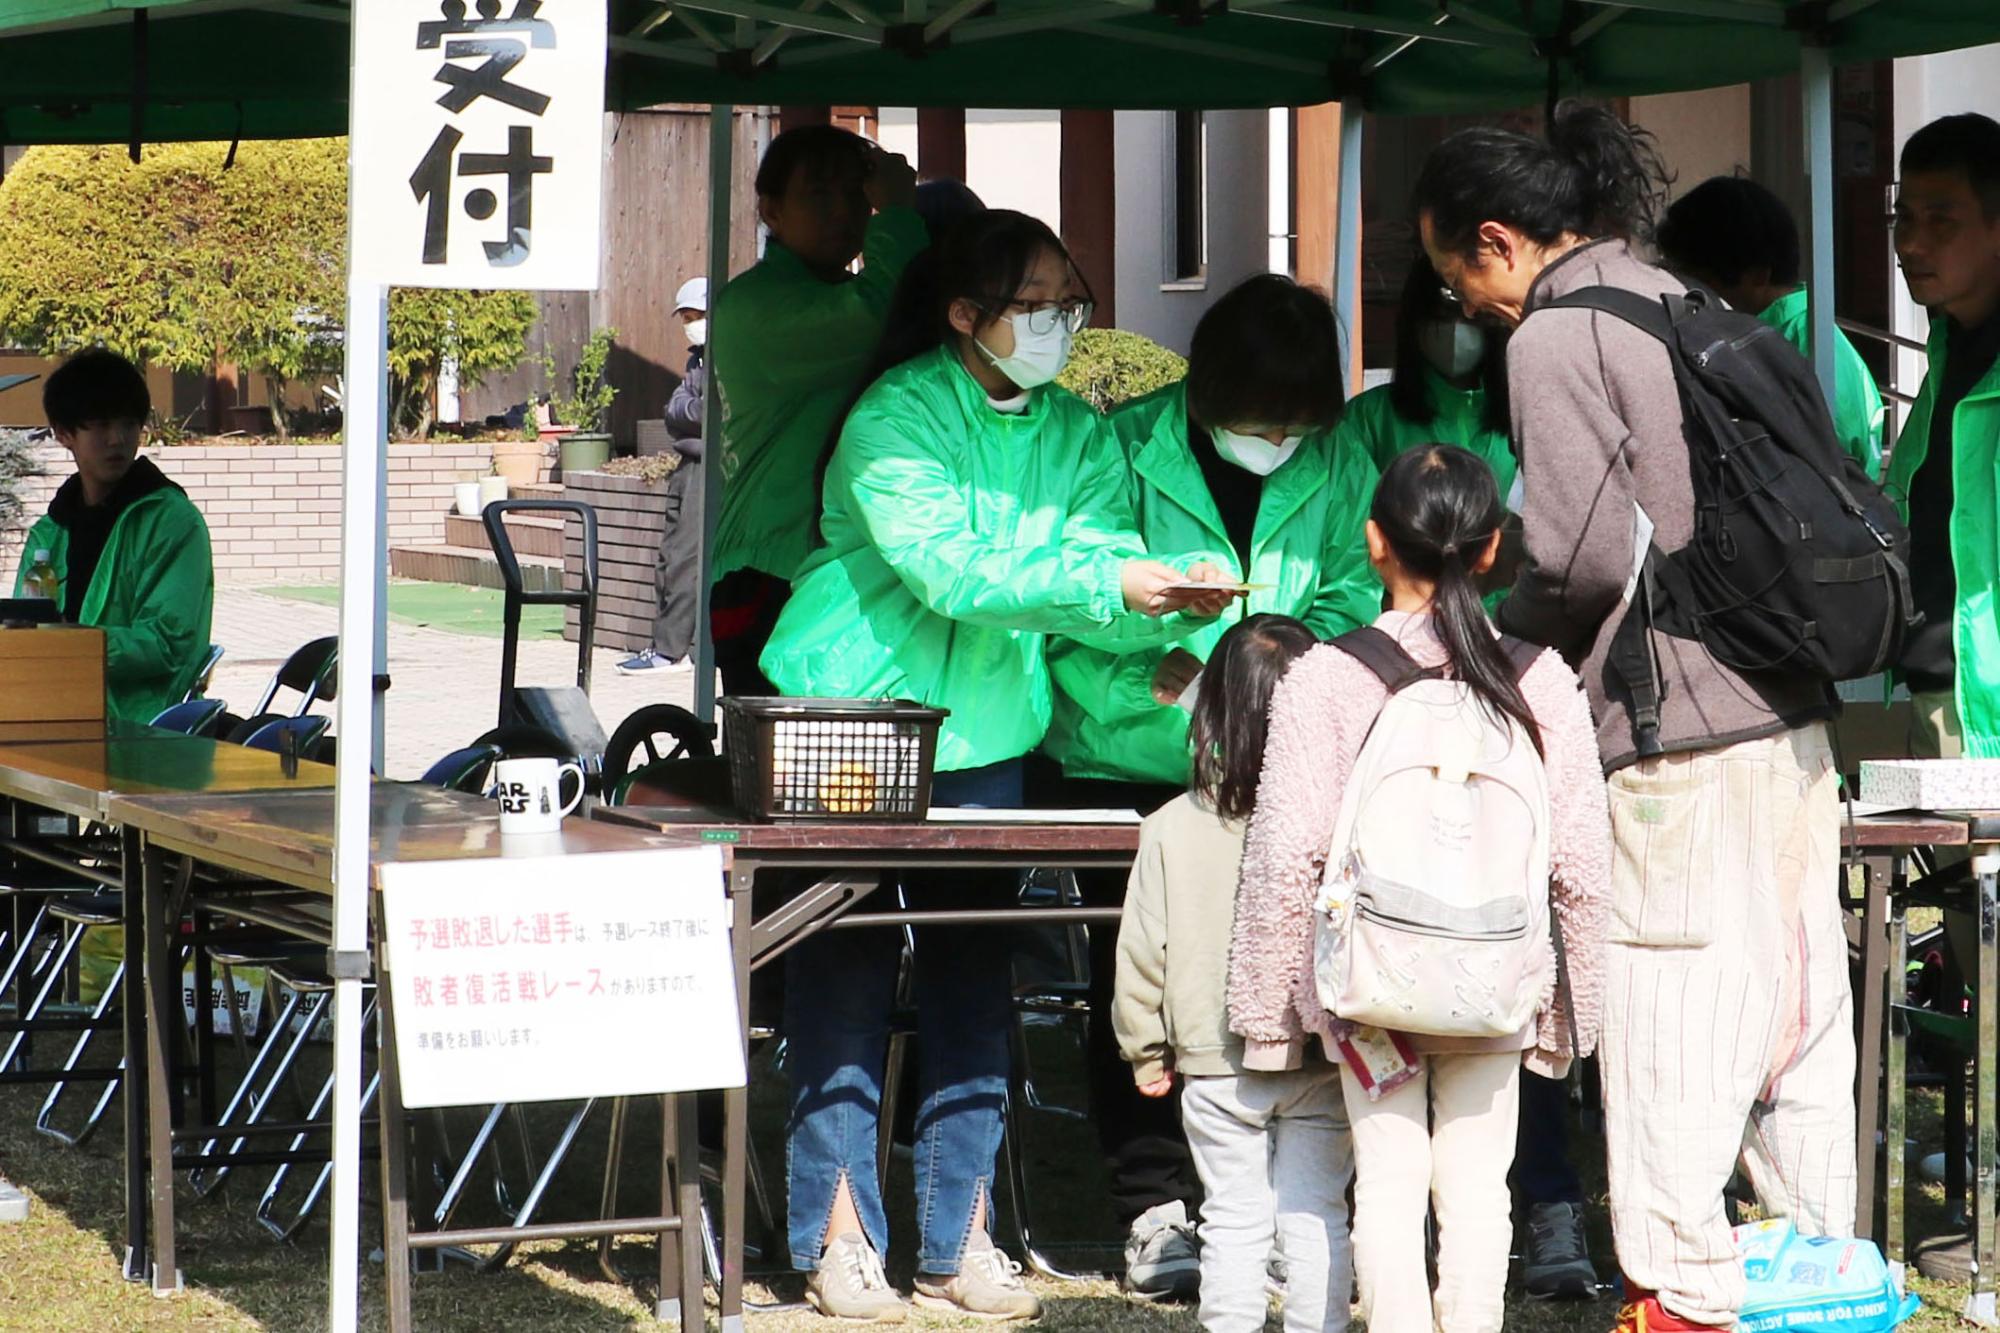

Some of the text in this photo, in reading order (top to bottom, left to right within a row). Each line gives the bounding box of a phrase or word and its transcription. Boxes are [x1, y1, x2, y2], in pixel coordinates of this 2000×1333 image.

[409, 0, 556, 267] 受付
[1787, 1312, 1824, 1326] SOME
[1827, 1307, 1850, 1322] FOR
[1740, 1314, 1784, 1333] ACTION
